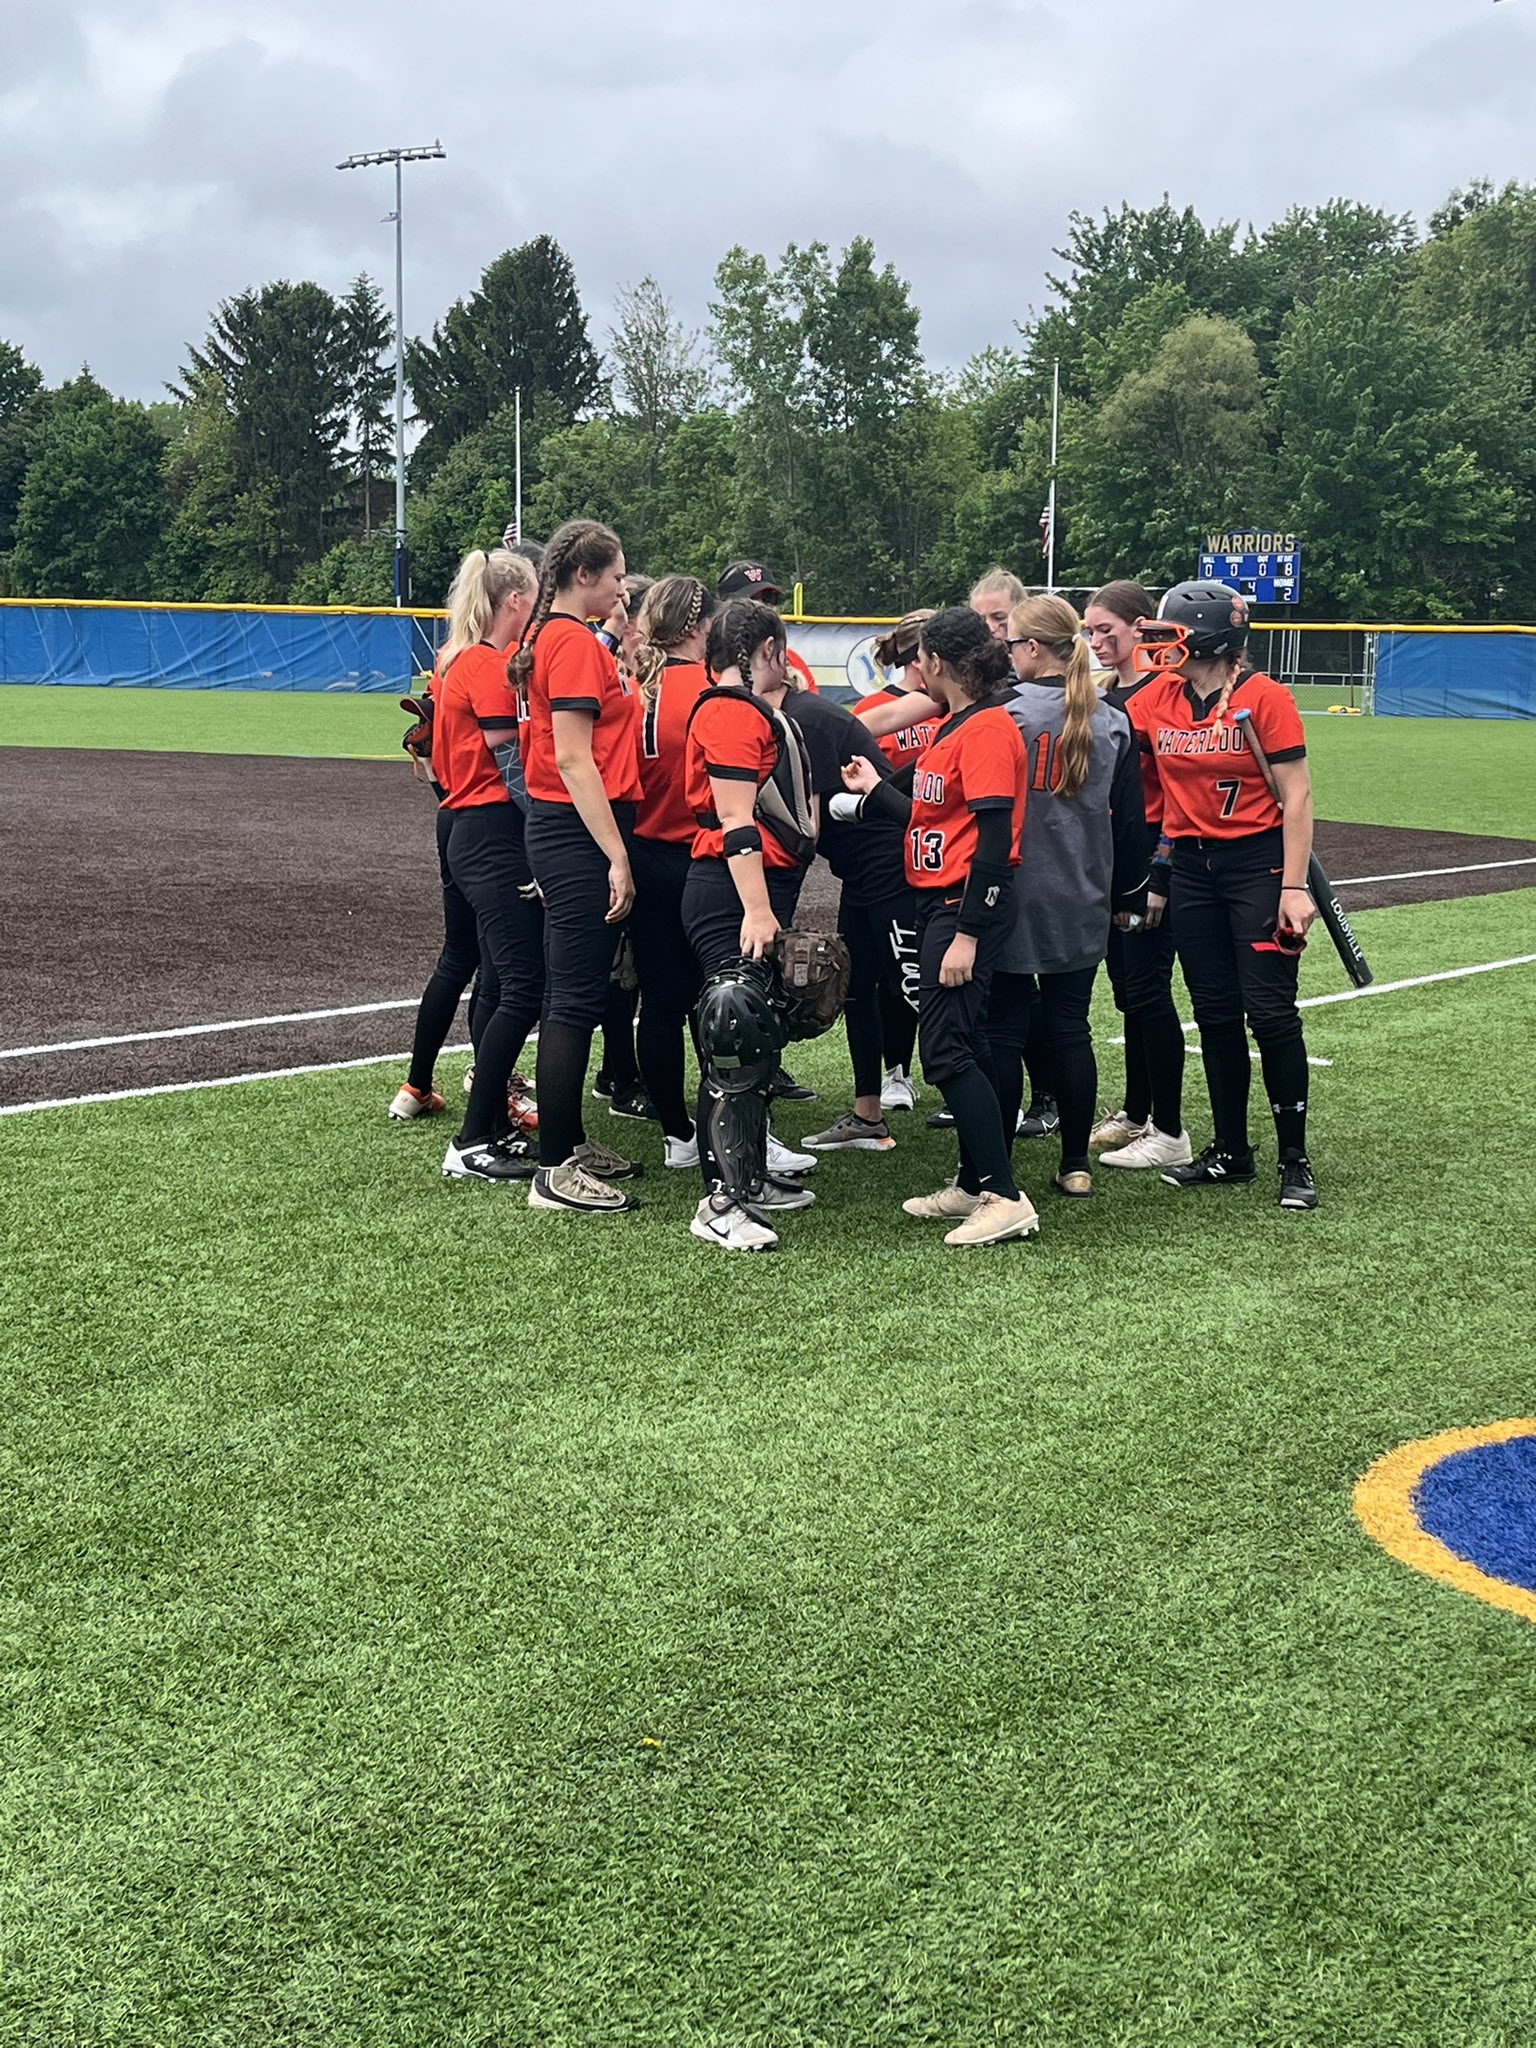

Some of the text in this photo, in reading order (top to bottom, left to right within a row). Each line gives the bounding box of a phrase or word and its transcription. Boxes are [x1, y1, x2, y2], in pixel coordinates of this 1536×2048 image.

[1207, 534, 1295, 553] WARRIORS
[1205, 562, 1293, 577] 0 0 0 8
[1248, 582, 1256, 592] 4
[1273, 579, 1294, 587] HOME
[1284, 588, 1292, 601] 2
[895, 725, 936, 751] WAT
[1156, 725, 1243, 756] WATERLOO
[1216, 778, 1241, 819] 7
[911, 826, 945, 871] 13
[1330, 897, 1363, 962] LOUISVILLE
